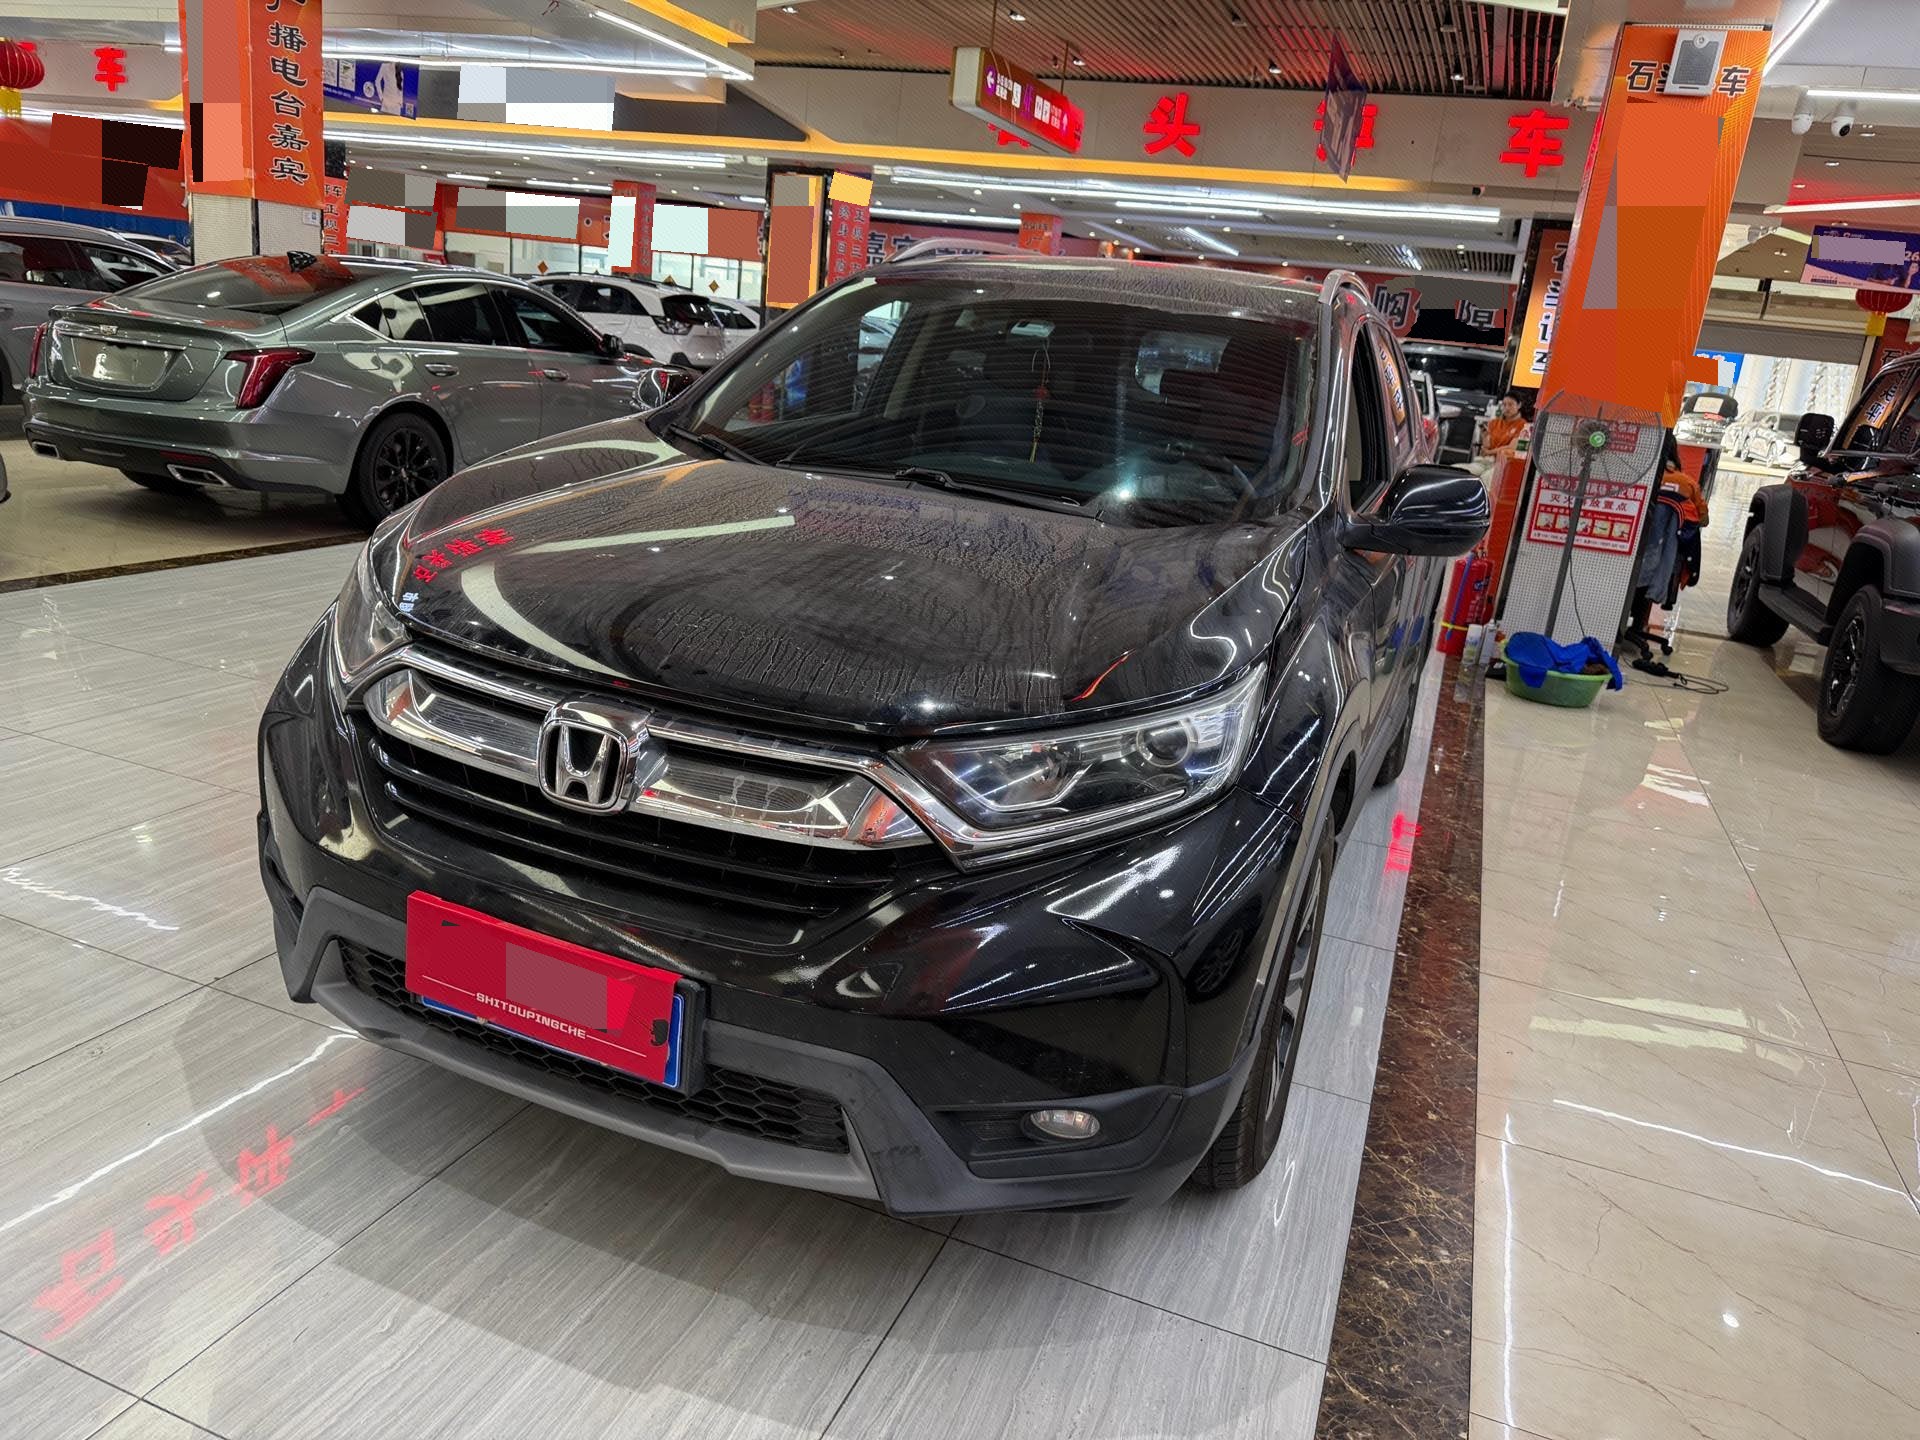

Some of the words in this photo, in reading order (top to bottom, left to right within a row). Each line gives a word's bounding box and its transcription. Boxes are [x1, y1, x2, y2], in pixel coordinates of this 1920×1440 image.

[94, 47, 128, 91] 车
[1626, 59, 1751, 98] 石车
[475, 991, 587, 1040] SHITOUPINGCHE
